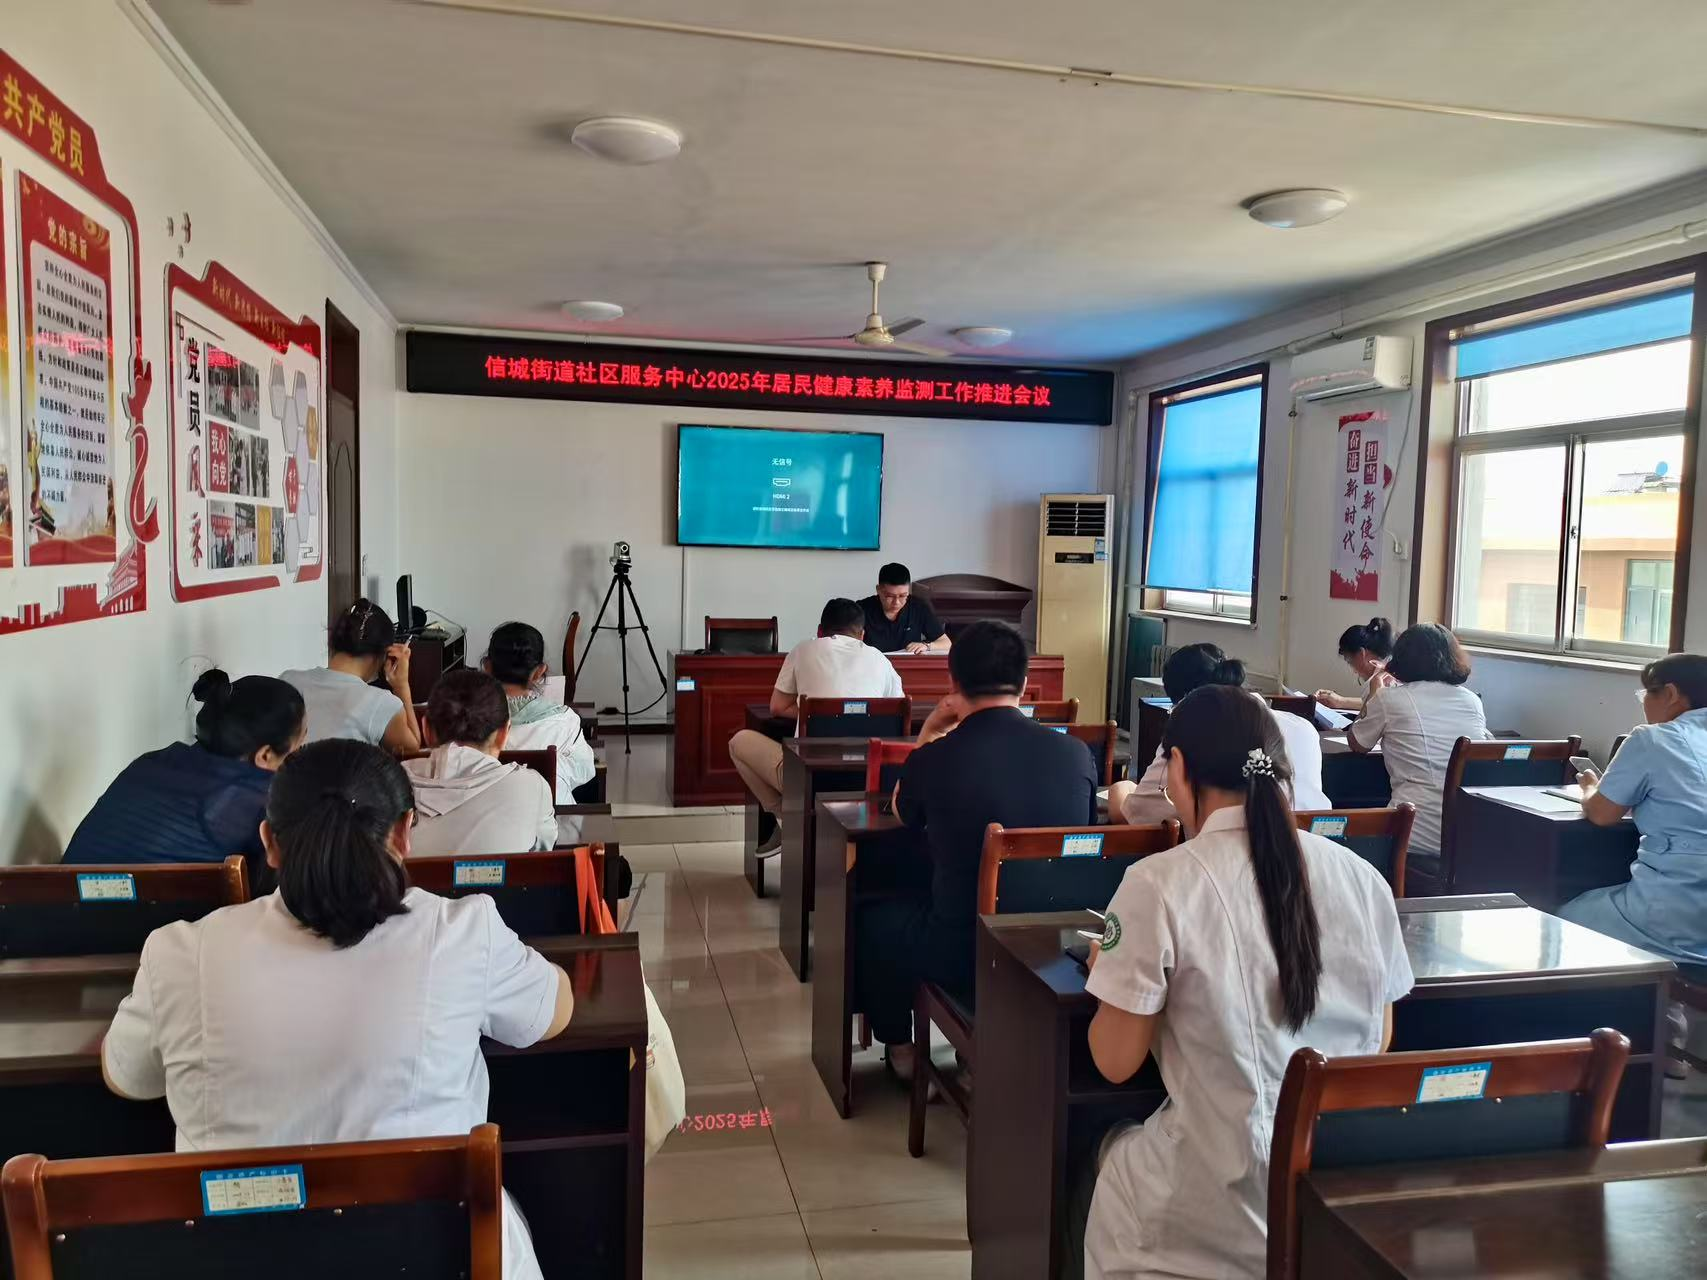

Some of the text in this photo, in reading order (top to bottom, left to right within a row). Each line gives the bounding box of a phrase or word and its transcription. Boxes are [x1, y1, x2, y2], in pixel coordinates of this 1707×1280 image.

[3, 73, 85, 176] 共产党员
[484, 354, 1051, 406] 信城街道社区服务中心2025年居民健康素养监测工作推进会议
[772, 458, 792, 466] 无信号
